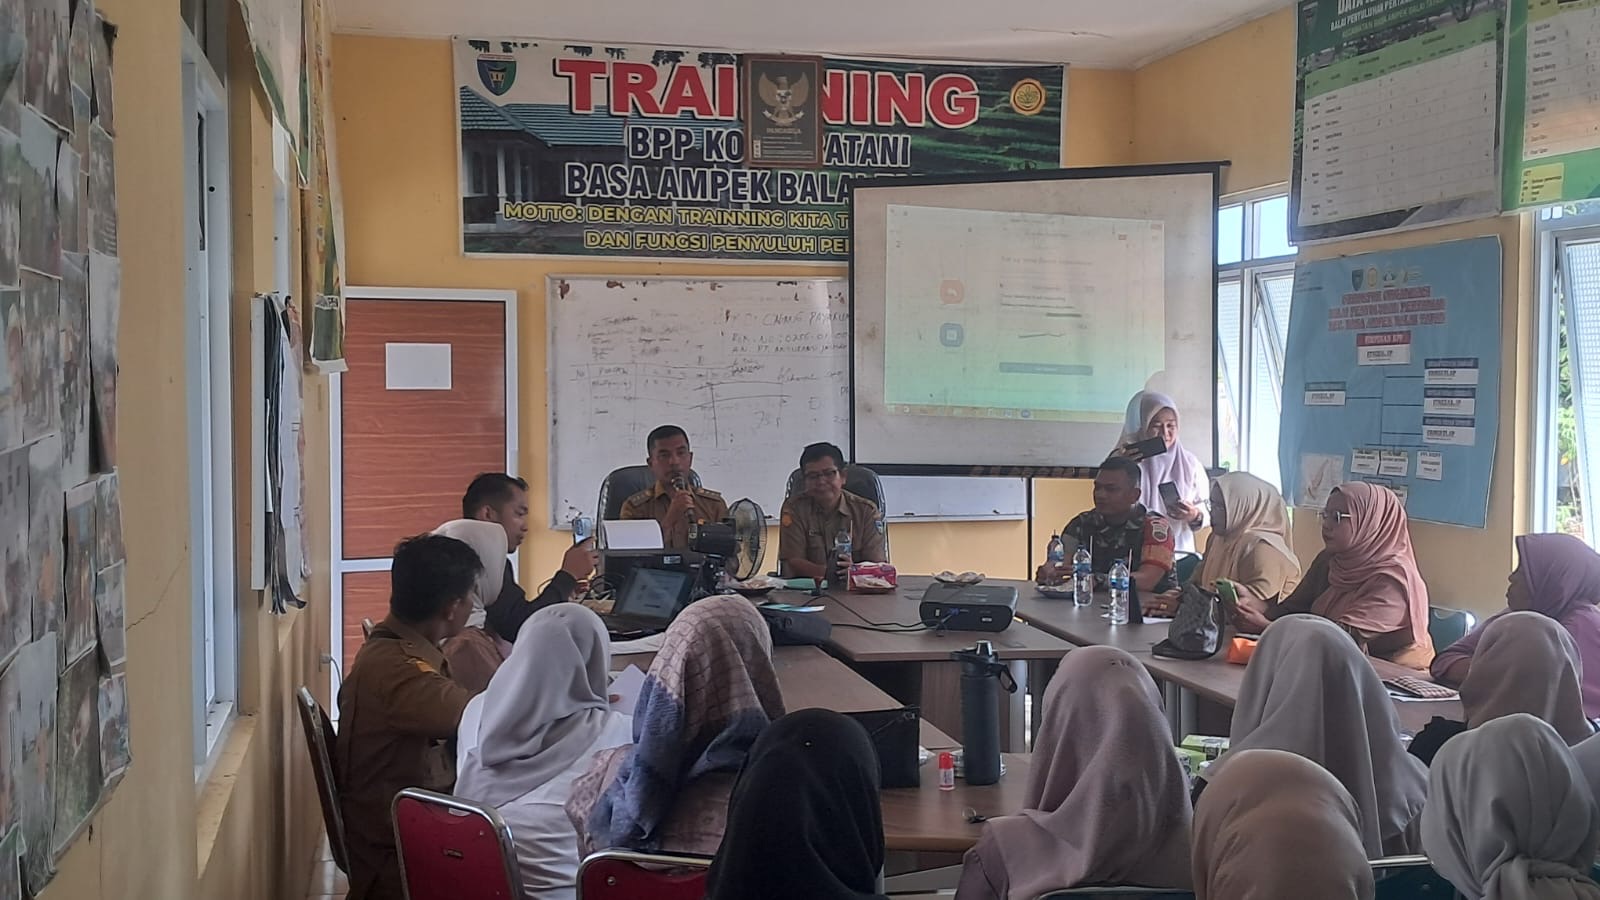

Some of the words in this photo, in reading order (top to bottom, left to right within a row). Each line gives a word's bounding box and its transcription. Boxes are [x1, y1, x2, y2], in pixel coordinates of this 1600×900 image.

[628, 126, 695, 160] BPP
[564, 161, 649, 199] BASA
[660, 167, 771, 203] AMPEK
[504, 203, 584, 224] MOTTO:
[587, 204, 674, 226] DENGAN
[676, 209, 785, 229] TRAINNING
[788, 211, 833, 230] KITA
[584, 231, 631, 250] DAN
[635, 232, 707, 252] FUNGSI
[712, 235, 816, 255] PENYULUH
